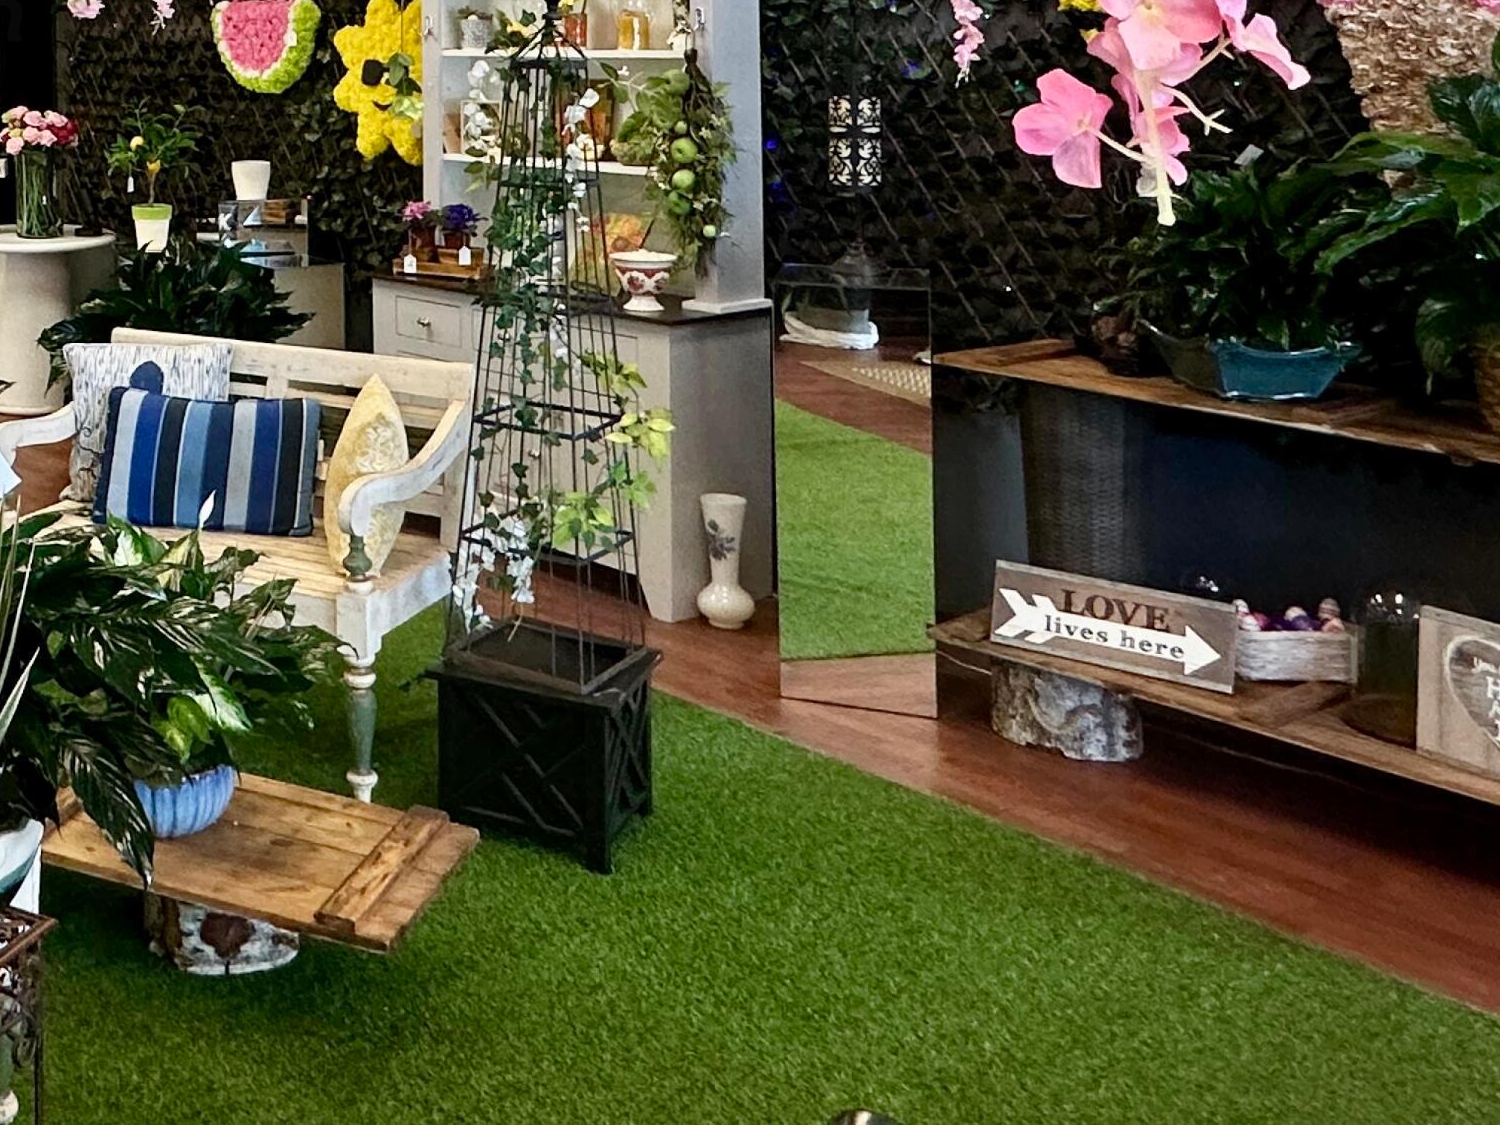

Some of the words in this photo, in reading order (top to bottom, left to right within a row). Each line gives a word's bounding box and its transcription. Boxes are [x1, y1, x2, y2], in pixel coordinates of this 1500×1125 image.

[1061, 589, 1171, 632] LOVE
[1043, 614, 1109, 643] lives
[1119, 629, 1185, 659] here
